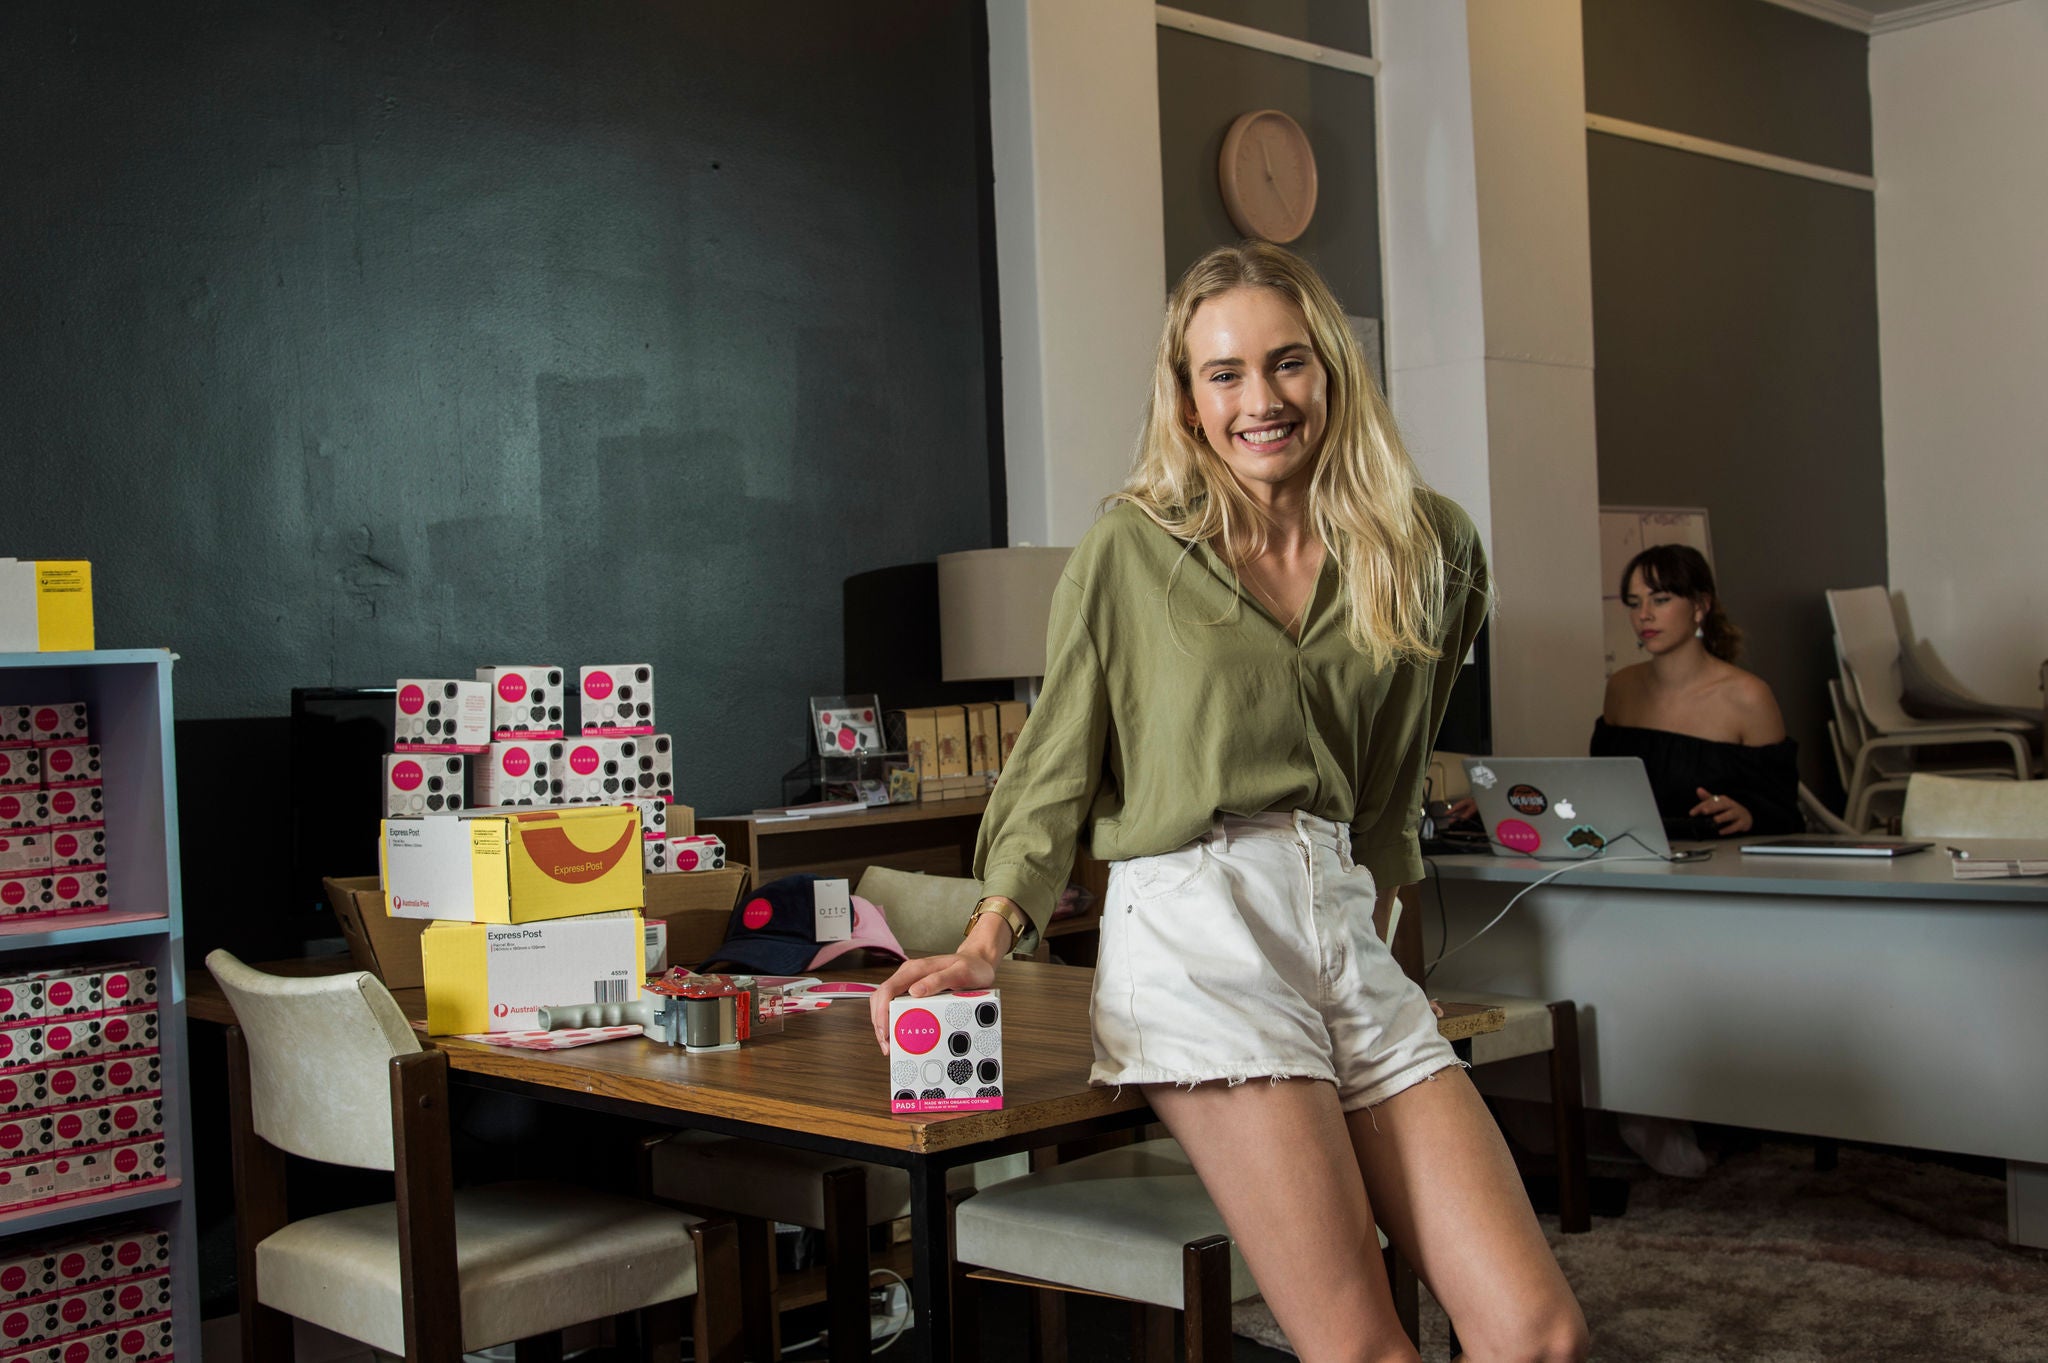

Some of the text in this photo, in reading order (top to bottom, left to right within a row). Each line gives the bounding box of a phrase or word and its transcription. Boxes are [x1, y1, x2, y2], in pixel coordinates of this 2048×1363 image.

[389, 828, 420, 837] Express Post
[554, 861, 603, 876] Express Post
[488, 929, 543, 942] Express Post
[510, 1005, 540, 1014] Australi
